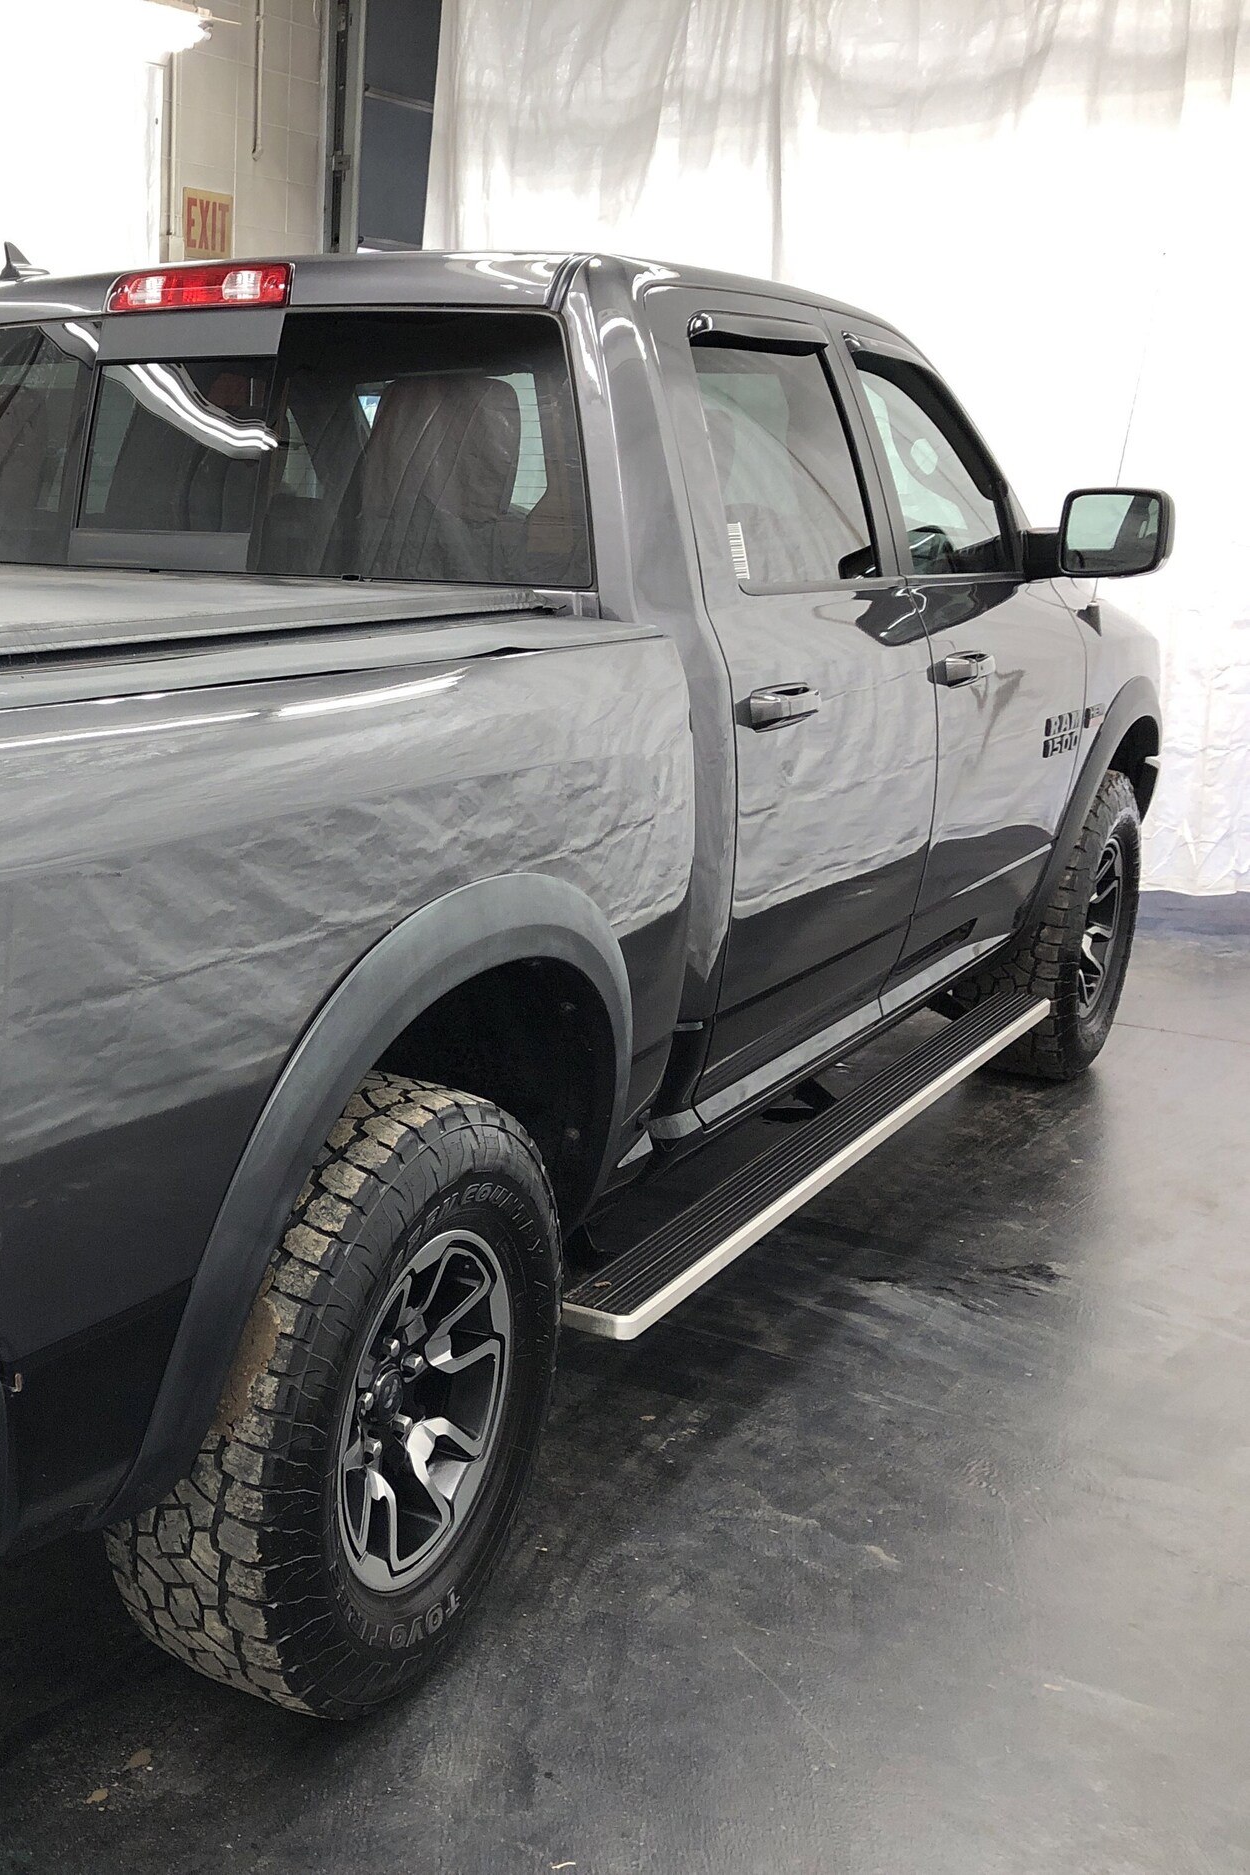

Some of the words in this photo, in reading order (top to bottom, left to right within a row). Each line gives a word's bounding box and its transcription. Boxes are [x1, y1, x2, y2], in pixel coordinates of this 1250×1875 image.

[186, 196, 230, 253] EXIT
[1042, 731, 1079, 758] 1500
[1045, 710, 1082, 737] RAM
[389, 1586, 461, 1650] TOYO
